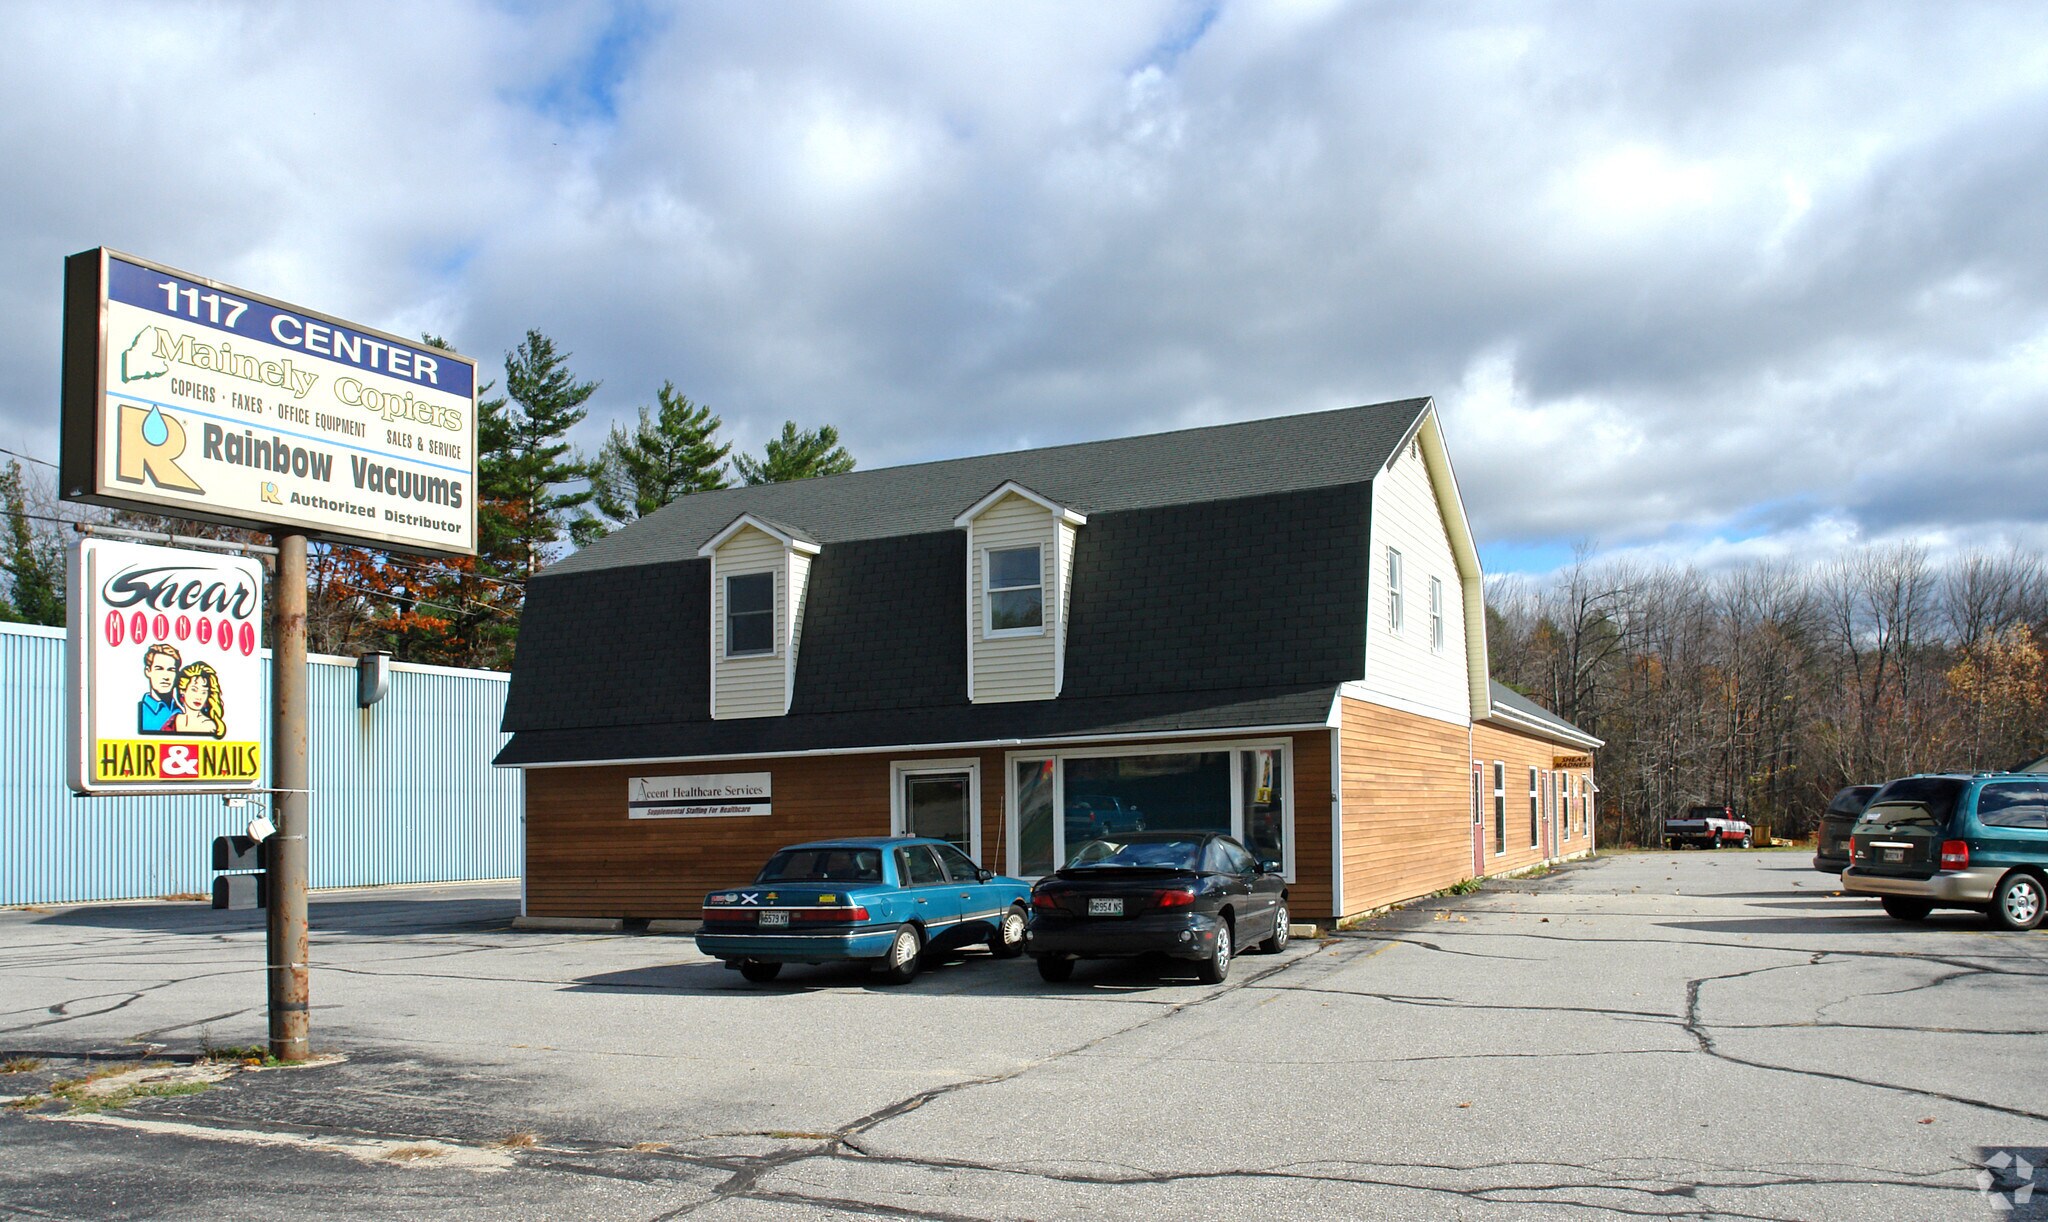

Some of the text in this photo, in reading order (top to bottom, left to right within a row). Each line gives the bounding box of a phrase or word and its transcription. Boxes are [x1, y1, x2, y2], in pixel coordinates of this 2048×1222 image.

[158, 282, 438, 384] 1117 CENTER
[152, 327, 462, 431] Mainely Copiers
[171, 378, 461, 460] COPIERS FAXES OFFICE EQUIPMENT SALES & SERVICE
[203, 422, 463, 509] Rainbow Vacuums
[290, 492, 376, 518] Authorized
[384, 509, 462, 533] Distributor
[102, 563, 258, 620] Shear
[105, 609, 255, 656] MADNESS
[101, 743, 257, 777] HAIR & NAILS
[647, 807, 685, 816] Supplemental
[686, 806, 708, 815] Staffing
[708, 806, 718, 814] For
[673, 786, 722, 798] Healthcare
[725, 784, 763, 796] Services
